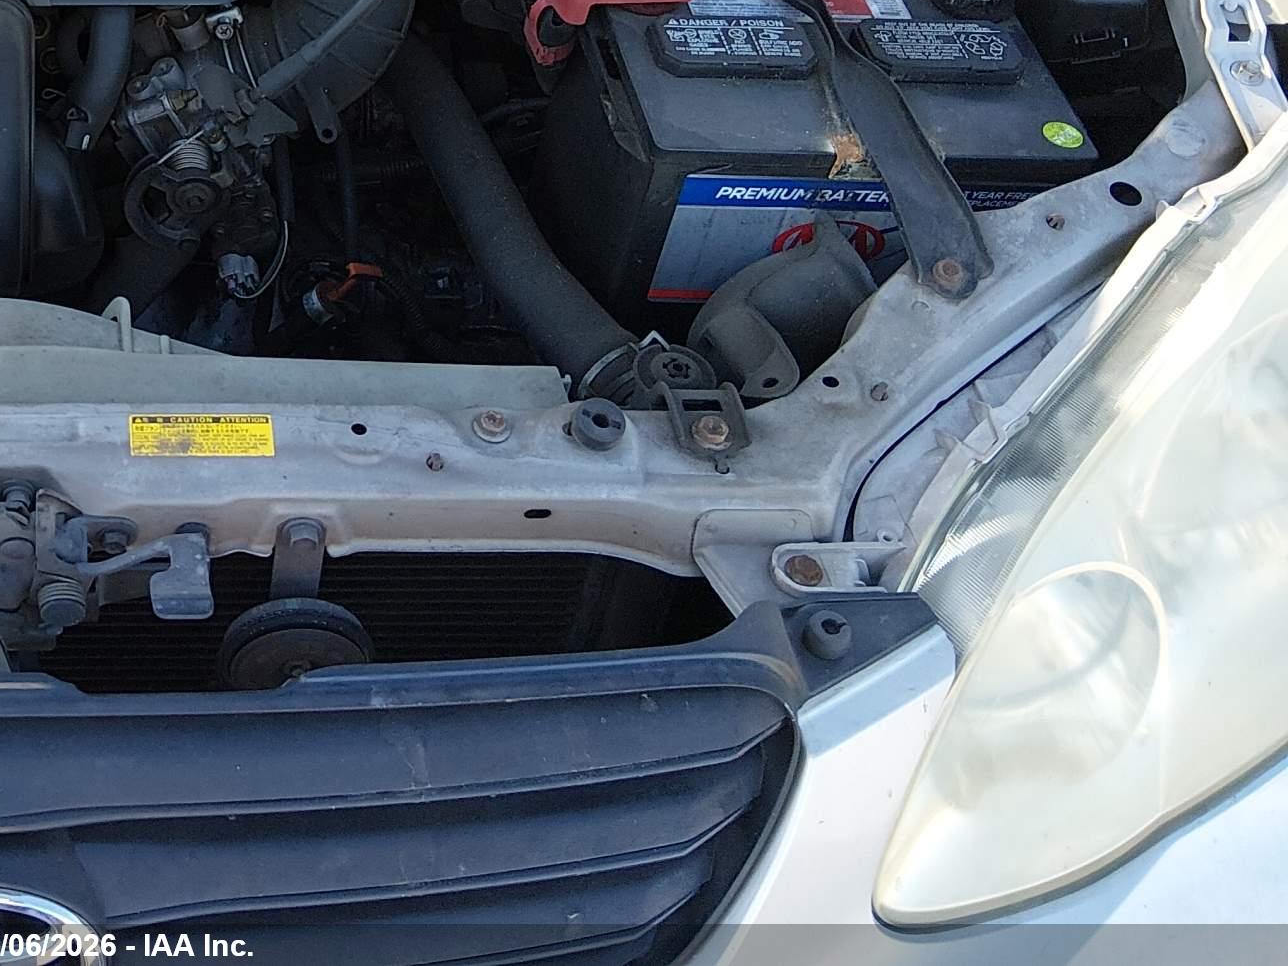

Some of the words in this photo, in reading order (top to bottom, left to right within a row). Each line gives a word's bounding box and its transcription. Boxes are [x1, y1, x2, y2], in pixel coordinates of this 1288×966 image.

[678, 18, 728, 26] DANGER
[739, 19, 785, 27] POISON
[715, 186, 812, 202] PREMIUM
[815, 189, 890, 203] BATTER
[972, 190, 1005, 200] YEAR
